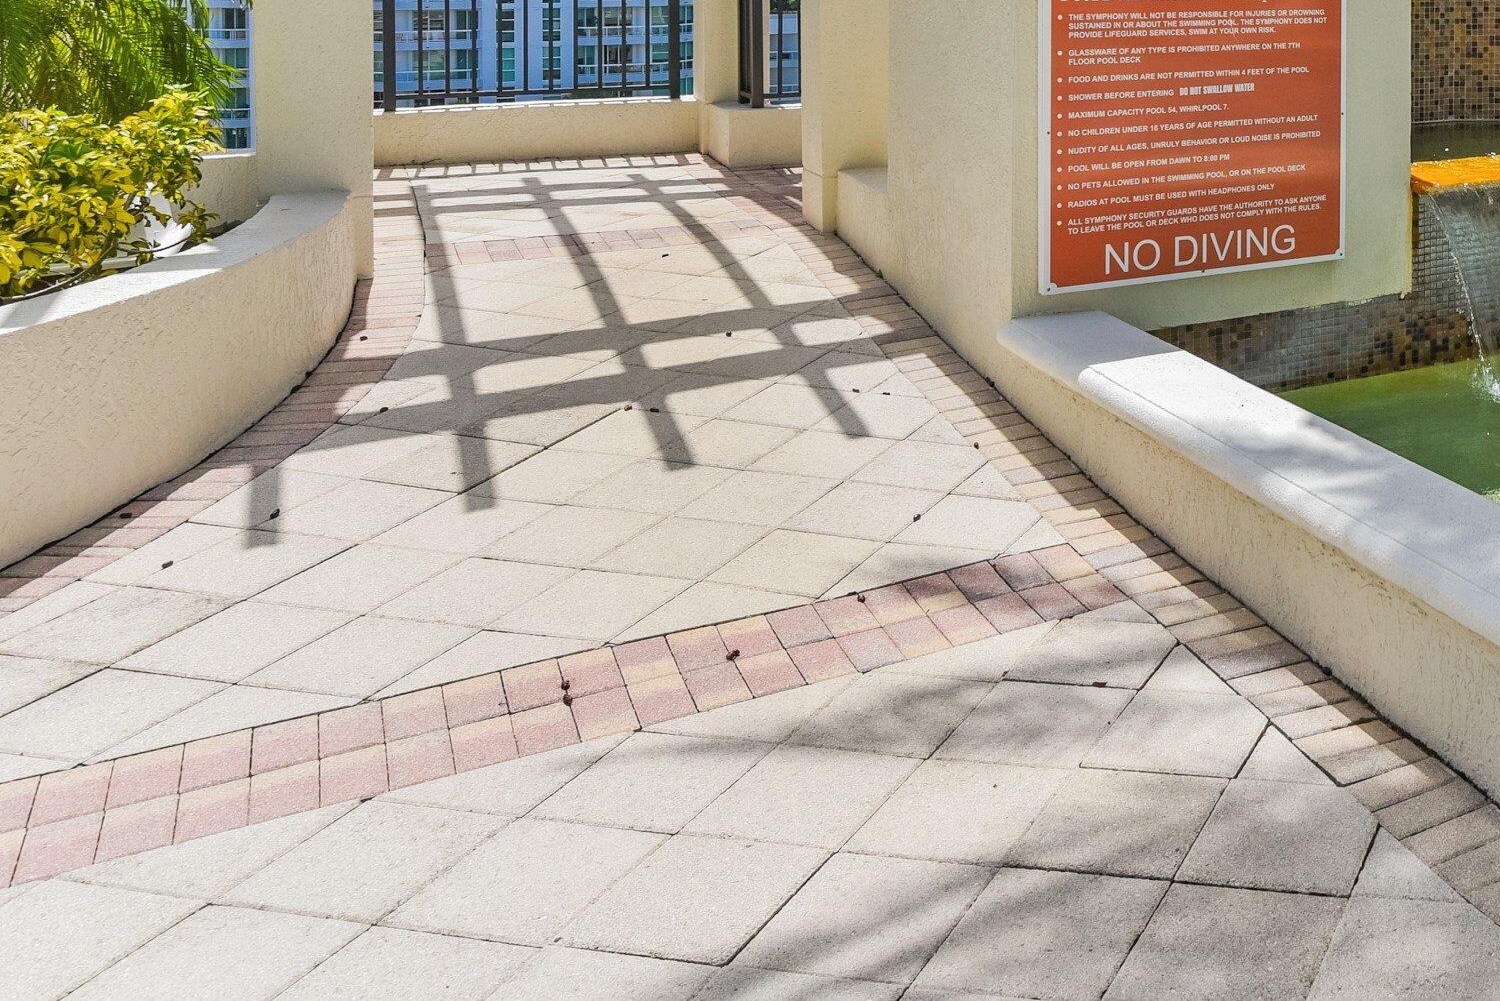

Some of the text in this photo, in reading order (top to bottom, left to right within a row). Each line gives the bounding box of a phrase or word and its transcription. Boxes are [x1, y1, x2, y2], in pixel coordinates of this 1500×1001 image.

[1069, 48, 1117, 56] GLASSWARE
[1177, 45, 1219, 53] PROHIBITED
[1069, 93, 1102, 101] SHOWER
[1105, 91, 1135, 99] BEFORE
[1190, 87, 1201, 95] NOT
[1203, 85, 1233, 94] SWALLOW
[1235, 83, 1254, 92] WATER
[1068, 110, 1105, 119] MAXIMUM
[1107, 108, 1144, 117] CAPACITY
[1146, 107, 1166, 115] POOL
[1180, 104, 1221, 113] WHIRLPOOL
[1082, 127, 1120, 136] CHILDREN
[1123, 125, 1148, 133] UNDER
[1160, 123, 1184, 131] YEARS
[1214, 119, 1252, 127] PERMITTED
[1254, 117, 1285, 125] WITHOUT
[1068, 146, 1096, 155] NUDITY
[1110, 144, 1124, 152] ALL
[1151, 140, 1180, 149] UNRULY
[1182, 138, 1217, 147] BEHAVIOR
[1252, 134, 1272, 142] NOISE
[1282, 131, 1320, 140] PROHIBITED
[1068, 164, 1089, 172] POOL
[1092, 163, 1109, 171] WILL
[1124, 160, 1144, 168] OPEN
[1170, 157, 1190, 165] DAWN
[1082, 181, 1101, 189] PETS
[1103, 178, 1140, 187] ALLOWED
[1167, 172, 1204, 182] SWIMMING
[1252, 167, 1266, 175] THE
[1268, 166, 1286, 174] POOL
[1287, 164, 1306, 172] DECK
[1068, 199, 1097, 208] RADIOS
[1111, 196, 1131, 204] POOL
[1133, 194, 1154, 202] MUST
[1167, 191, 1186, 199] USED
[1188, 189, 1206, 197] WITH
[1208, 185, 1255, 195] HEADPHONES
[1068, 218, 1083, 226] ALL
[1085, 214, 1127, 224] SYMPHONY
[1129, 210, 1164, 220] SECURITY
[1167, 207, 1198, 216] GUARDS
[1199, 205, 1217, 213] HAVE
[1234, 200, 1272, 210] AUTHORITY
[1284, 197, 1298, 205] ASK
[1300, 195, 1326, 203] ANYONE
[1081, 224, 1105, 233] LEAVE
[1107, 223, 1121, 231] THE
[1124, 221, 1143, 229] POOL
[1146, 219, 1157, 227] OR
[1159, 217, 1178, 226] DECK
[1181, 215, 1198, 223] WHO
[1199, 213, 1218, 222] DOES
[1237, 209, 1264, 218] COMPLY
[1266, 207, 1283, 215] WITH
[1299, 203, 1321, 212] RULES.
[1105, 224, 1296, 275] NO DIVING
